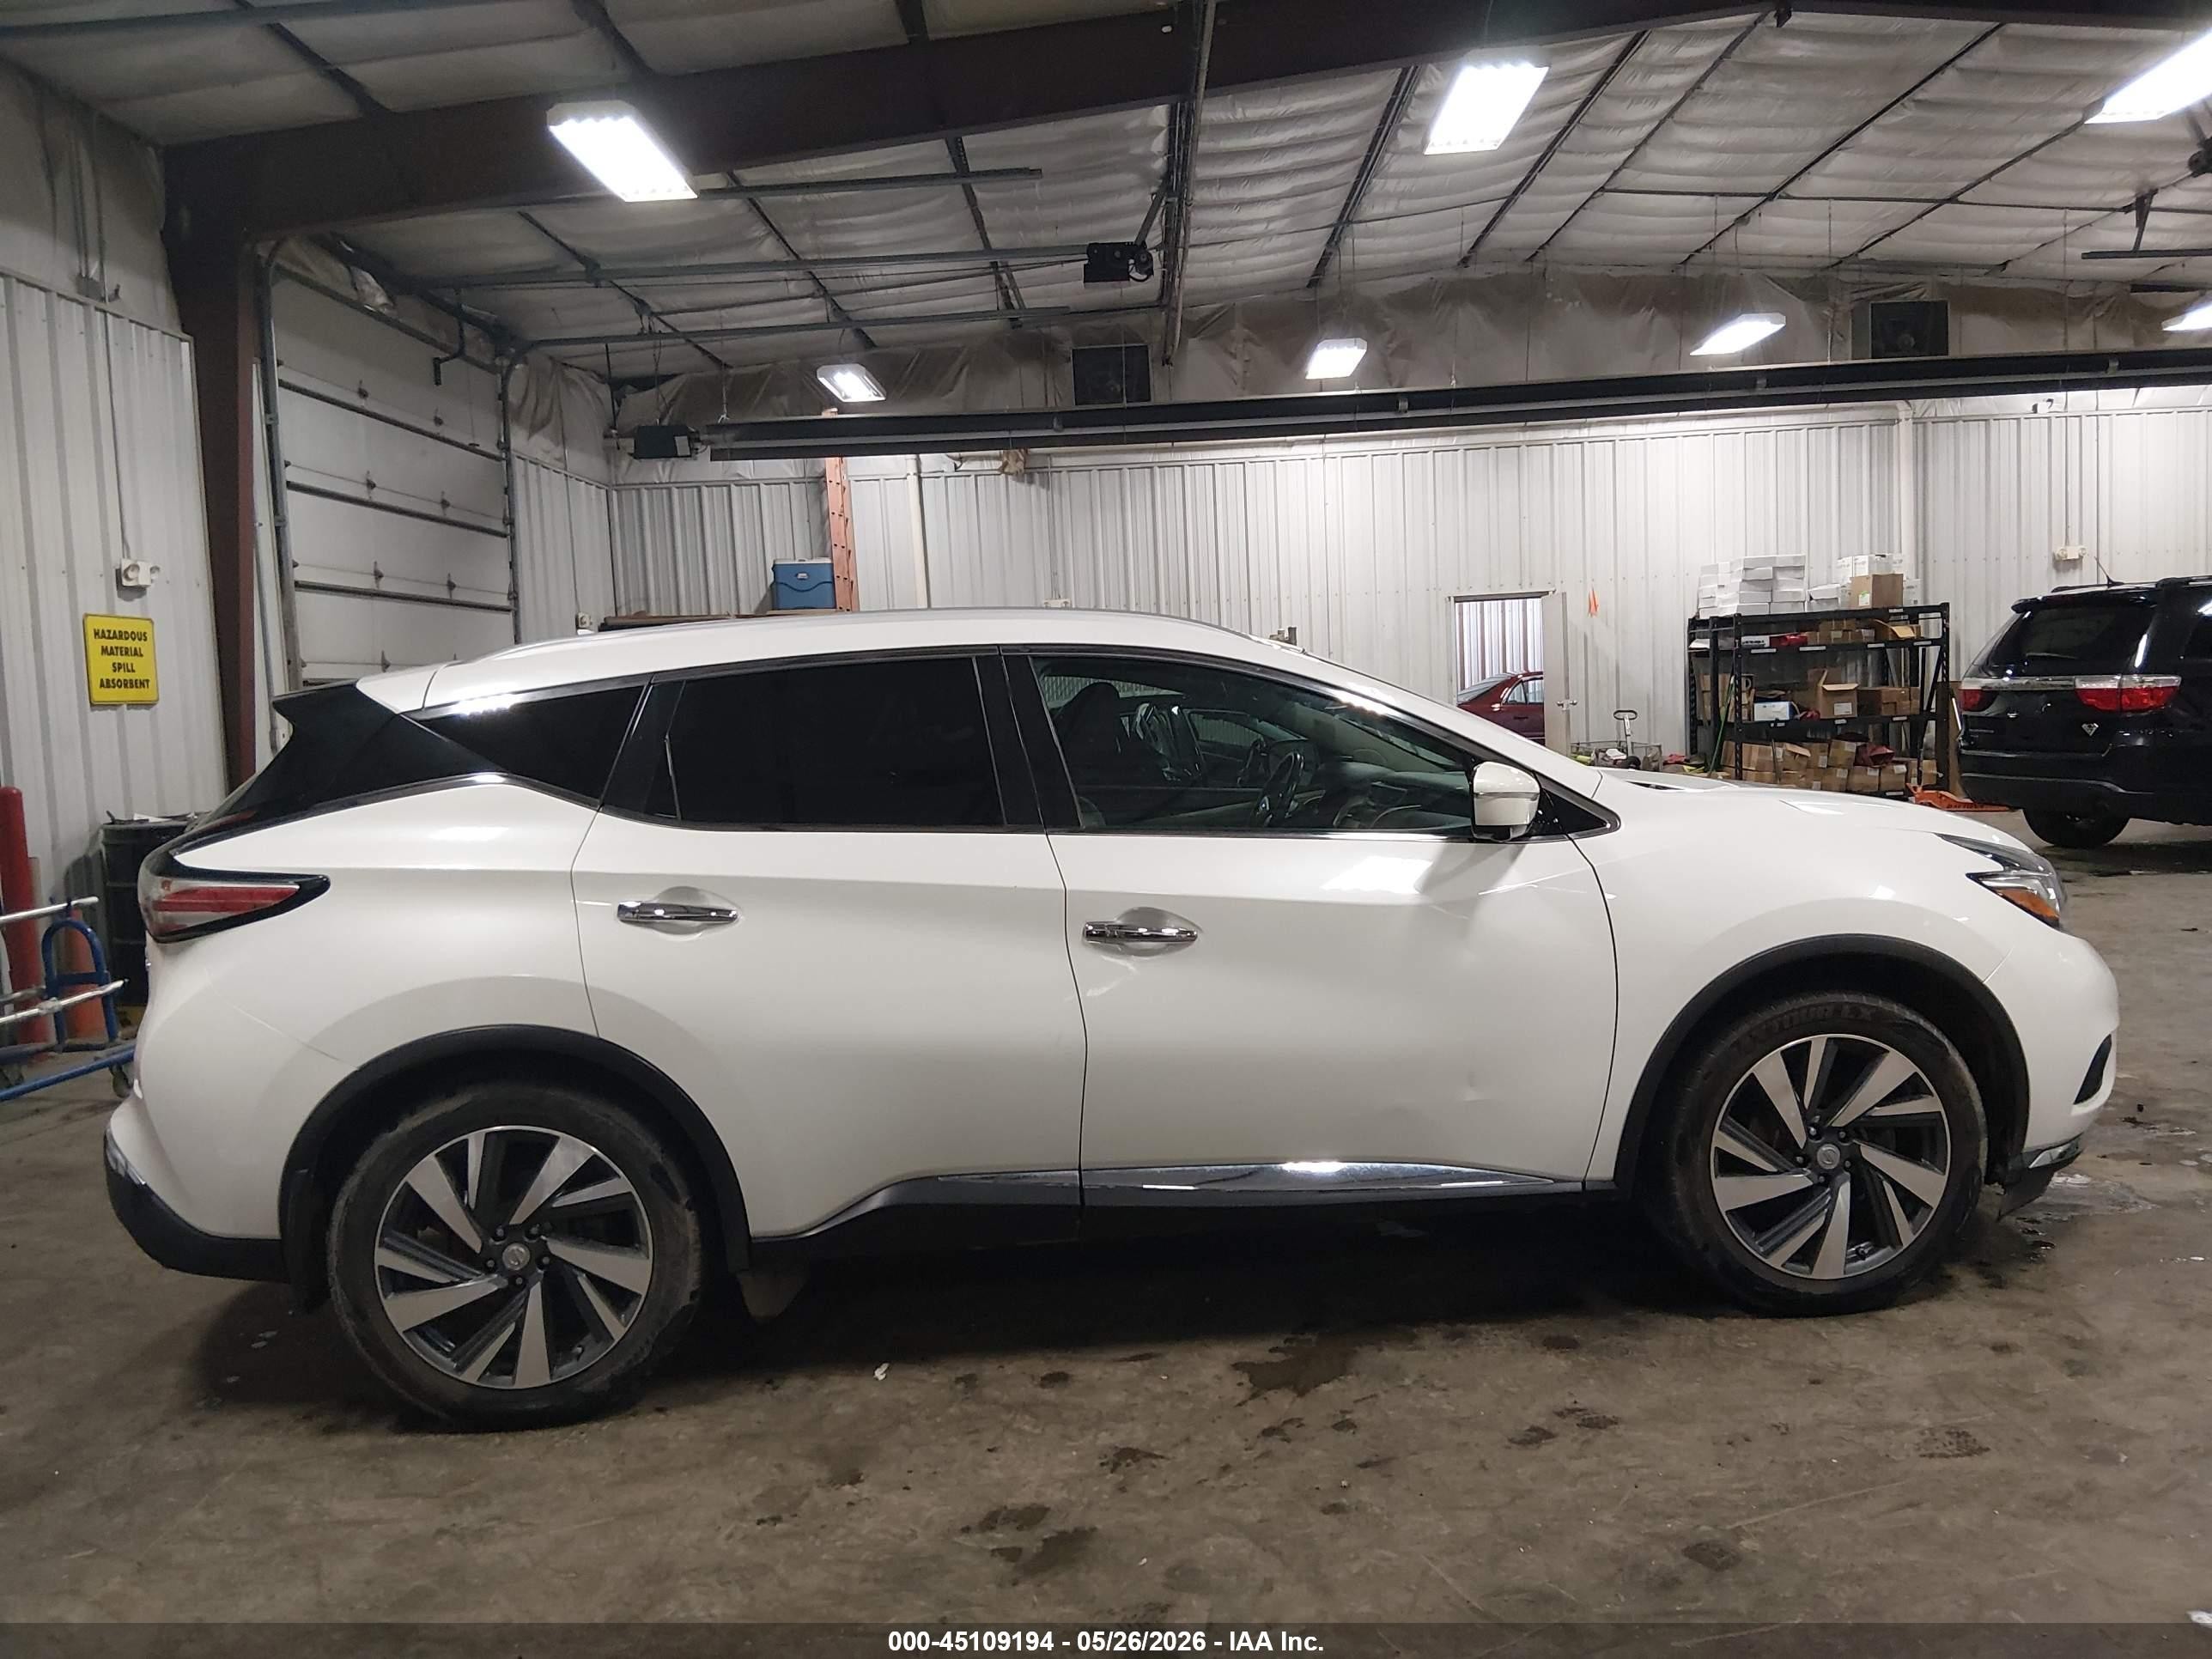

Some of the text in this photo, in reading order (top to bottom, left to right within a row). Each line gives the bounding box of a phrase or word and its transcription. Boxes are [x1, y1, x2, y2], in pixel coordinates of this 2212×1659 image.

[94, 629, 148, 641] HAZARDOUS
[100, 646, 143, 657] MATERIAL
[112, 662, 136, 672] SPILL
[100, 678, 150, 689] ABSORBENT
